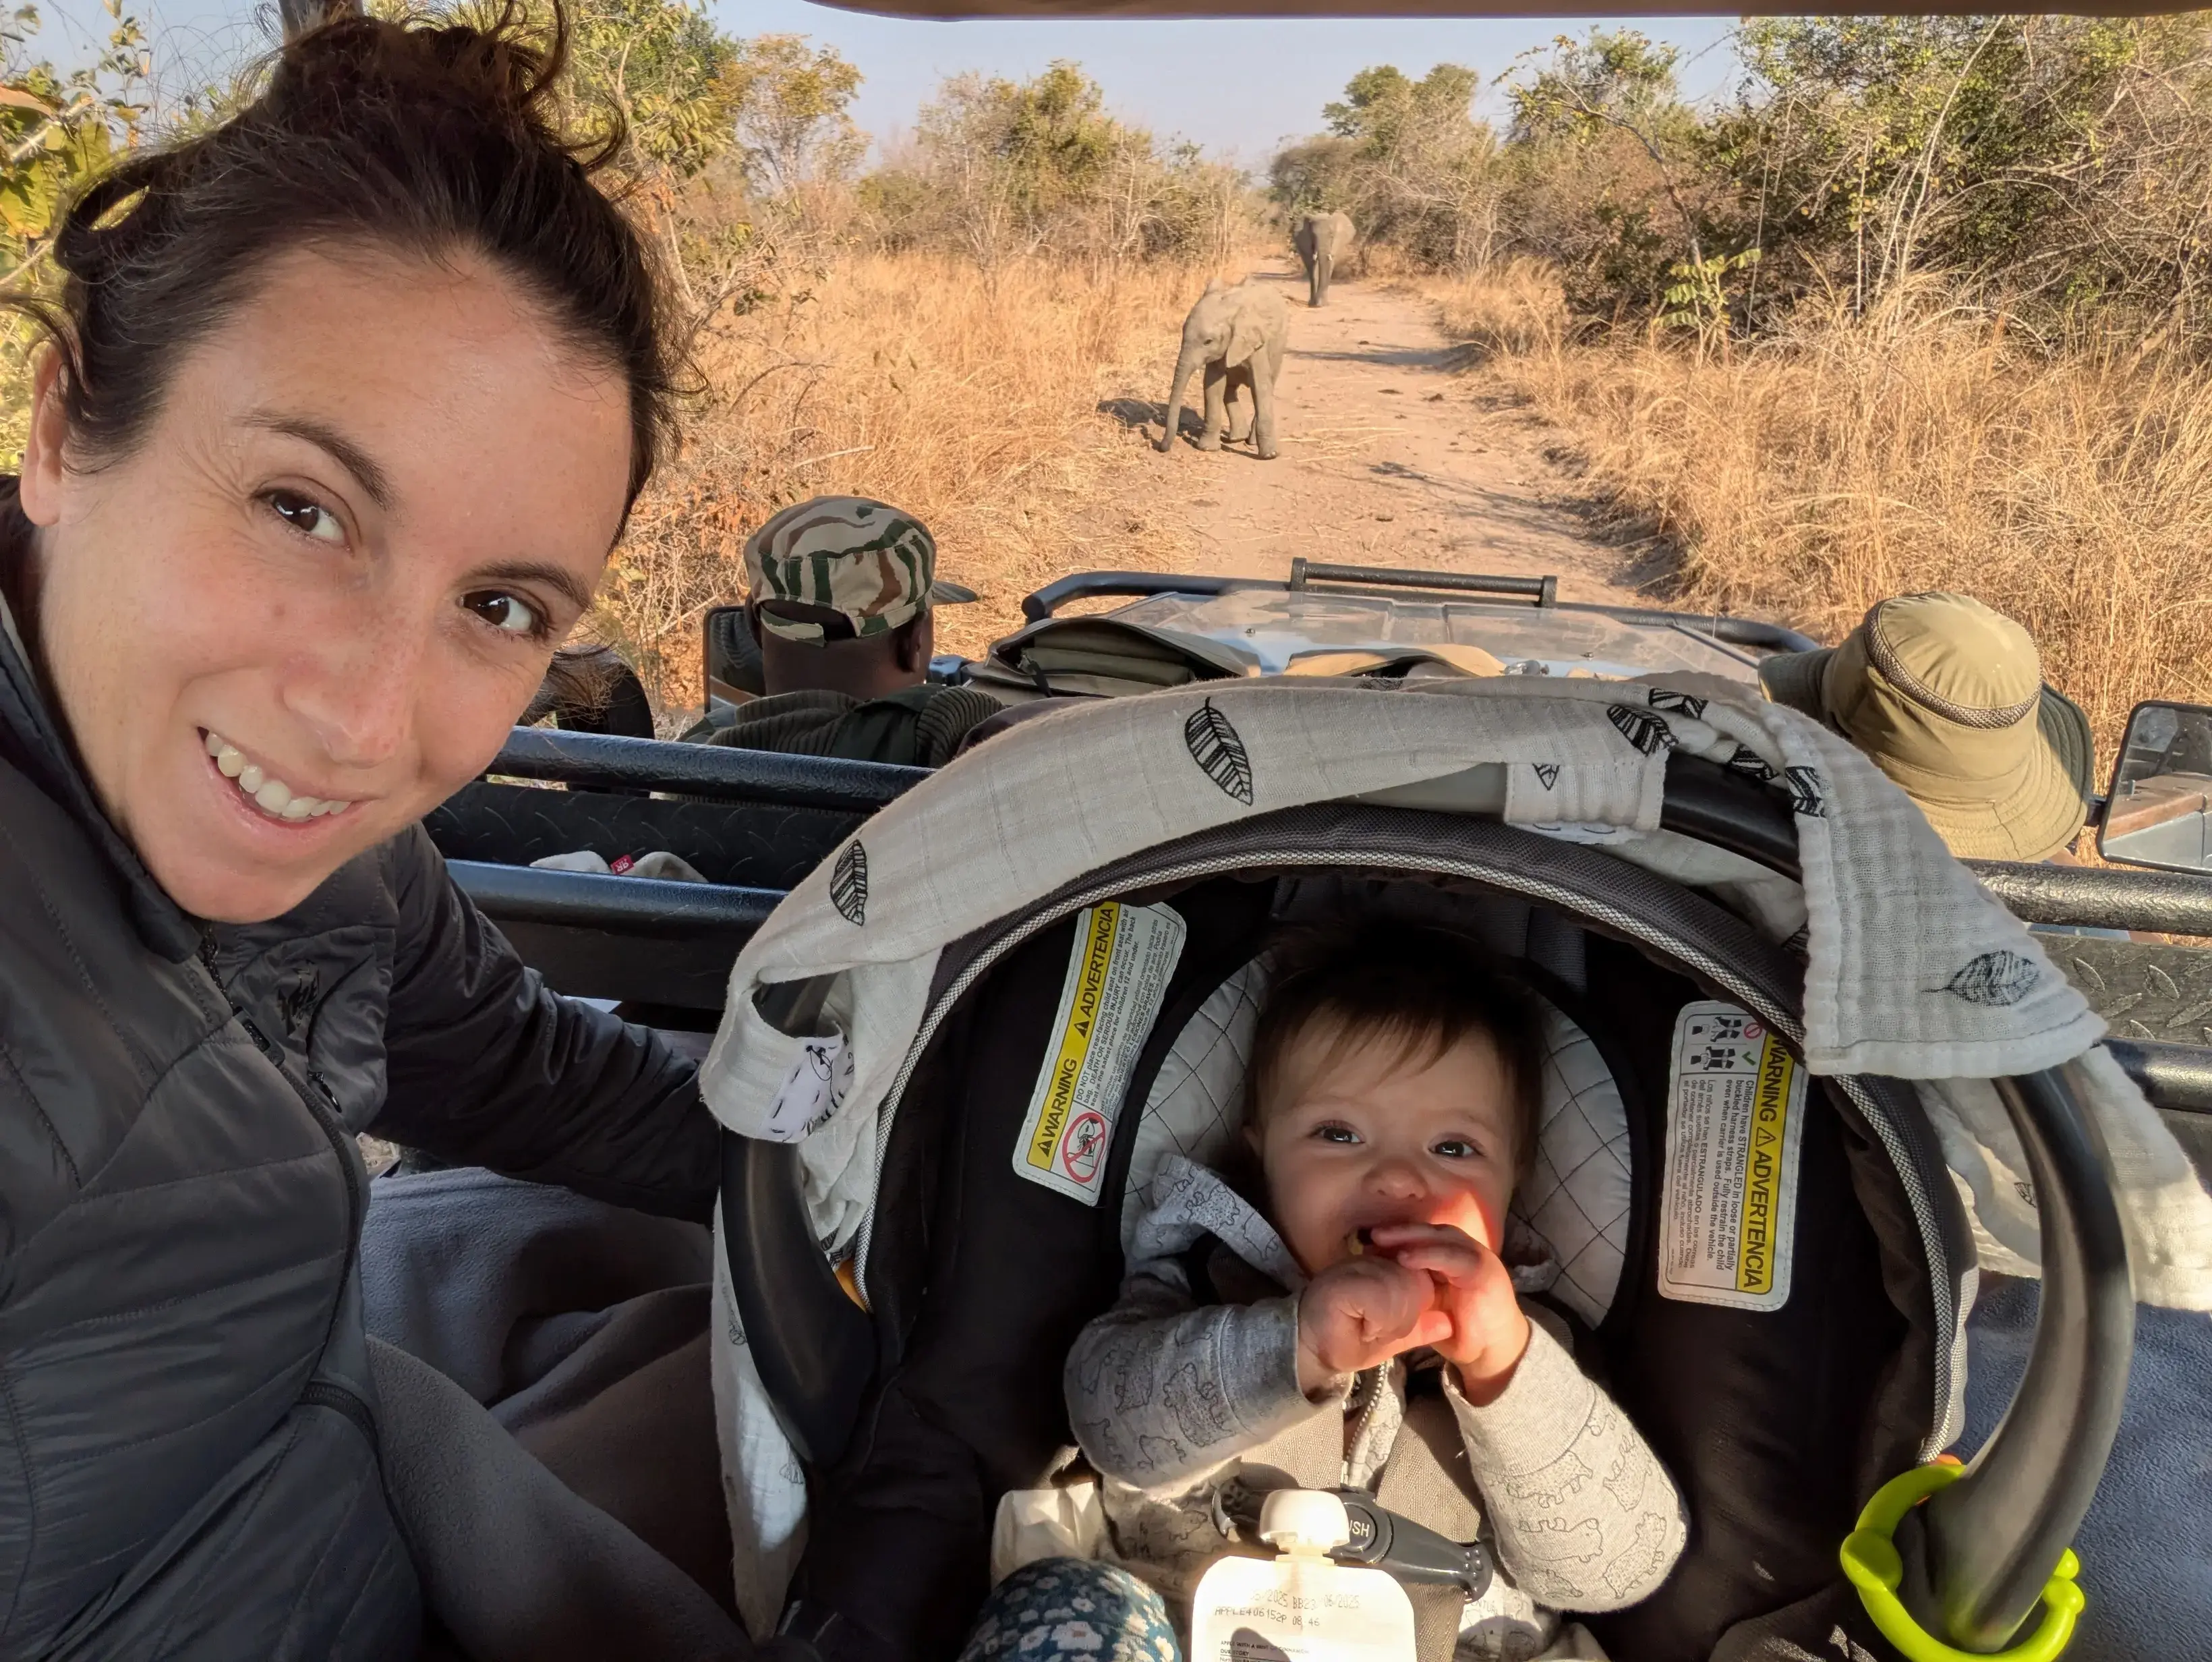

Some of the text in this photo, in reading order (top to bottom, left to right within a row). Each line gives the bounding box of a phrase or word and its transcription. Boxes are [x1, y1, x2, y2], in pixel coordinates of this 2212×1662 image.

[1119, 918, 1127, 932] with
[1116, 933, 1124, 948] seat
[1125, 932, 1133, 945] The
[1112, 948, 1122, 965] front
[1121, 948, 1129, 969] occur.
[1111, 966, 1117, 975] on
[1107, 976, 1115, 992] seat
[1101, 992, 1111, 1010] child
[1109, 983, 1121, 1011] INJURY
[1042, 906, 1115, 1139] WARNING ADVERTENCIA
[1088, 1090, 1099, 1106] seat
[1100, 1047, 1111, 1068] safest
[1107, 1027, 1118, 1047] place
[1115, 986, 1128, 1014] children
[1129, 940, 1139, 961] under.
[1090, 1011, 1108, 1050] rear-facing
[1100, 1011, 1114, 1044] SERIOUS
[1085, 1050, 1097, 1070] place
[1096, 1045, 1105, 1058] OR
[1080, 1070, 1090, 1087] NOT
[1089, 1058, 1101, 1084] DEATH
[1076, 1088, 1085, 1100] DO
[1082, 1087, 1094, 1104] bag.
[1724, 1079, 1732, 1098] even
[1721, 1099, 1730, 1120] when
[1718, 1122, 1728, 1149] carrier
[1714, 1159, 1723, 1180] used
[1743, 1037, 1788, 1289] WARNING ADVERTENCIA
[1693, 1142, 1708, 1213] ESTRANGULADO
[1716, 1079, 1743, 1270] buckled harness straps. Fully restrain the child
[1724, 1080, 1753, 1270] Children have STRANGLED in loose or partially
[1711, 1181, 1721, 1211] outside
[1710, 1213, 1718, 1227] the
[1706, 1229, 1716, 1261] vehicle.
